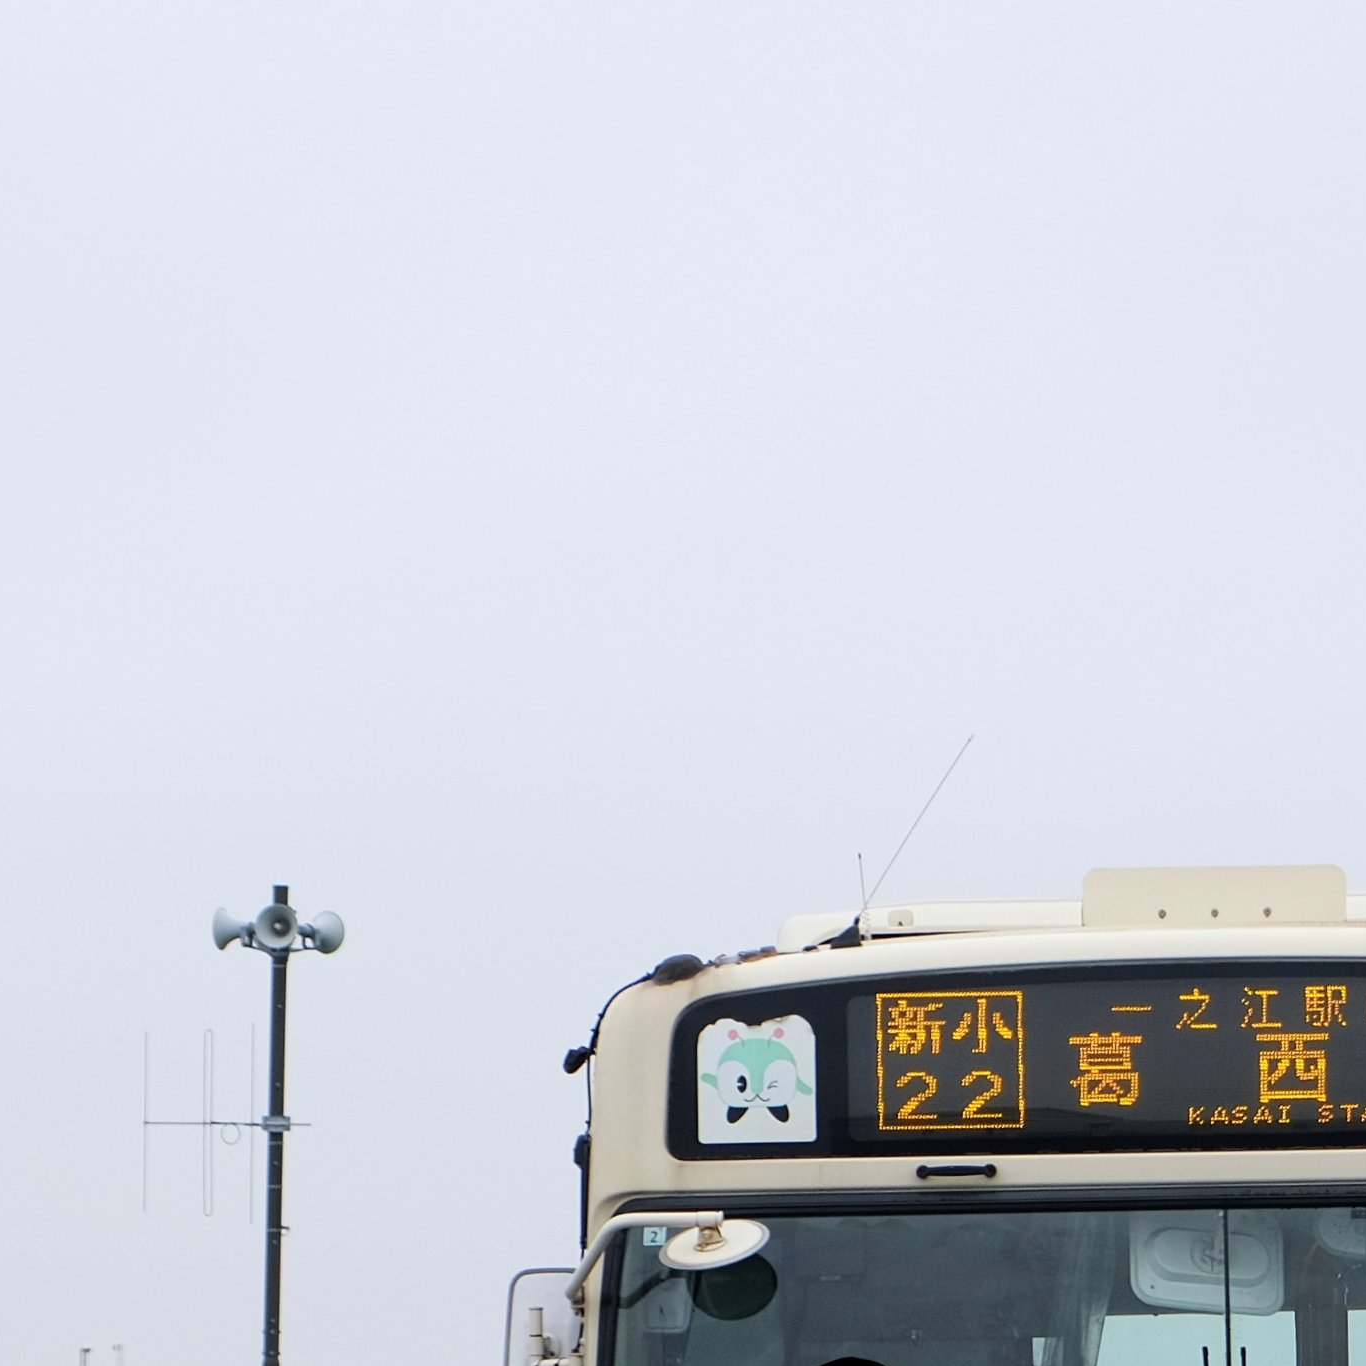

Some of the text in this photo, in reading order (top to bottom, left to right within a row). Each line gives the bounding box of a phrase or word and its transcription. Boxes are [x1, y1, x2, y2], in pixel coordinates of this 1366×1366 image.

[887, 998, 1013, 1054] 新小
[896, 1070, 1003, 1120] 22
[1187, 1103, 1291, 1126] KASAI
[650, 1231, 658, 1243] 2
